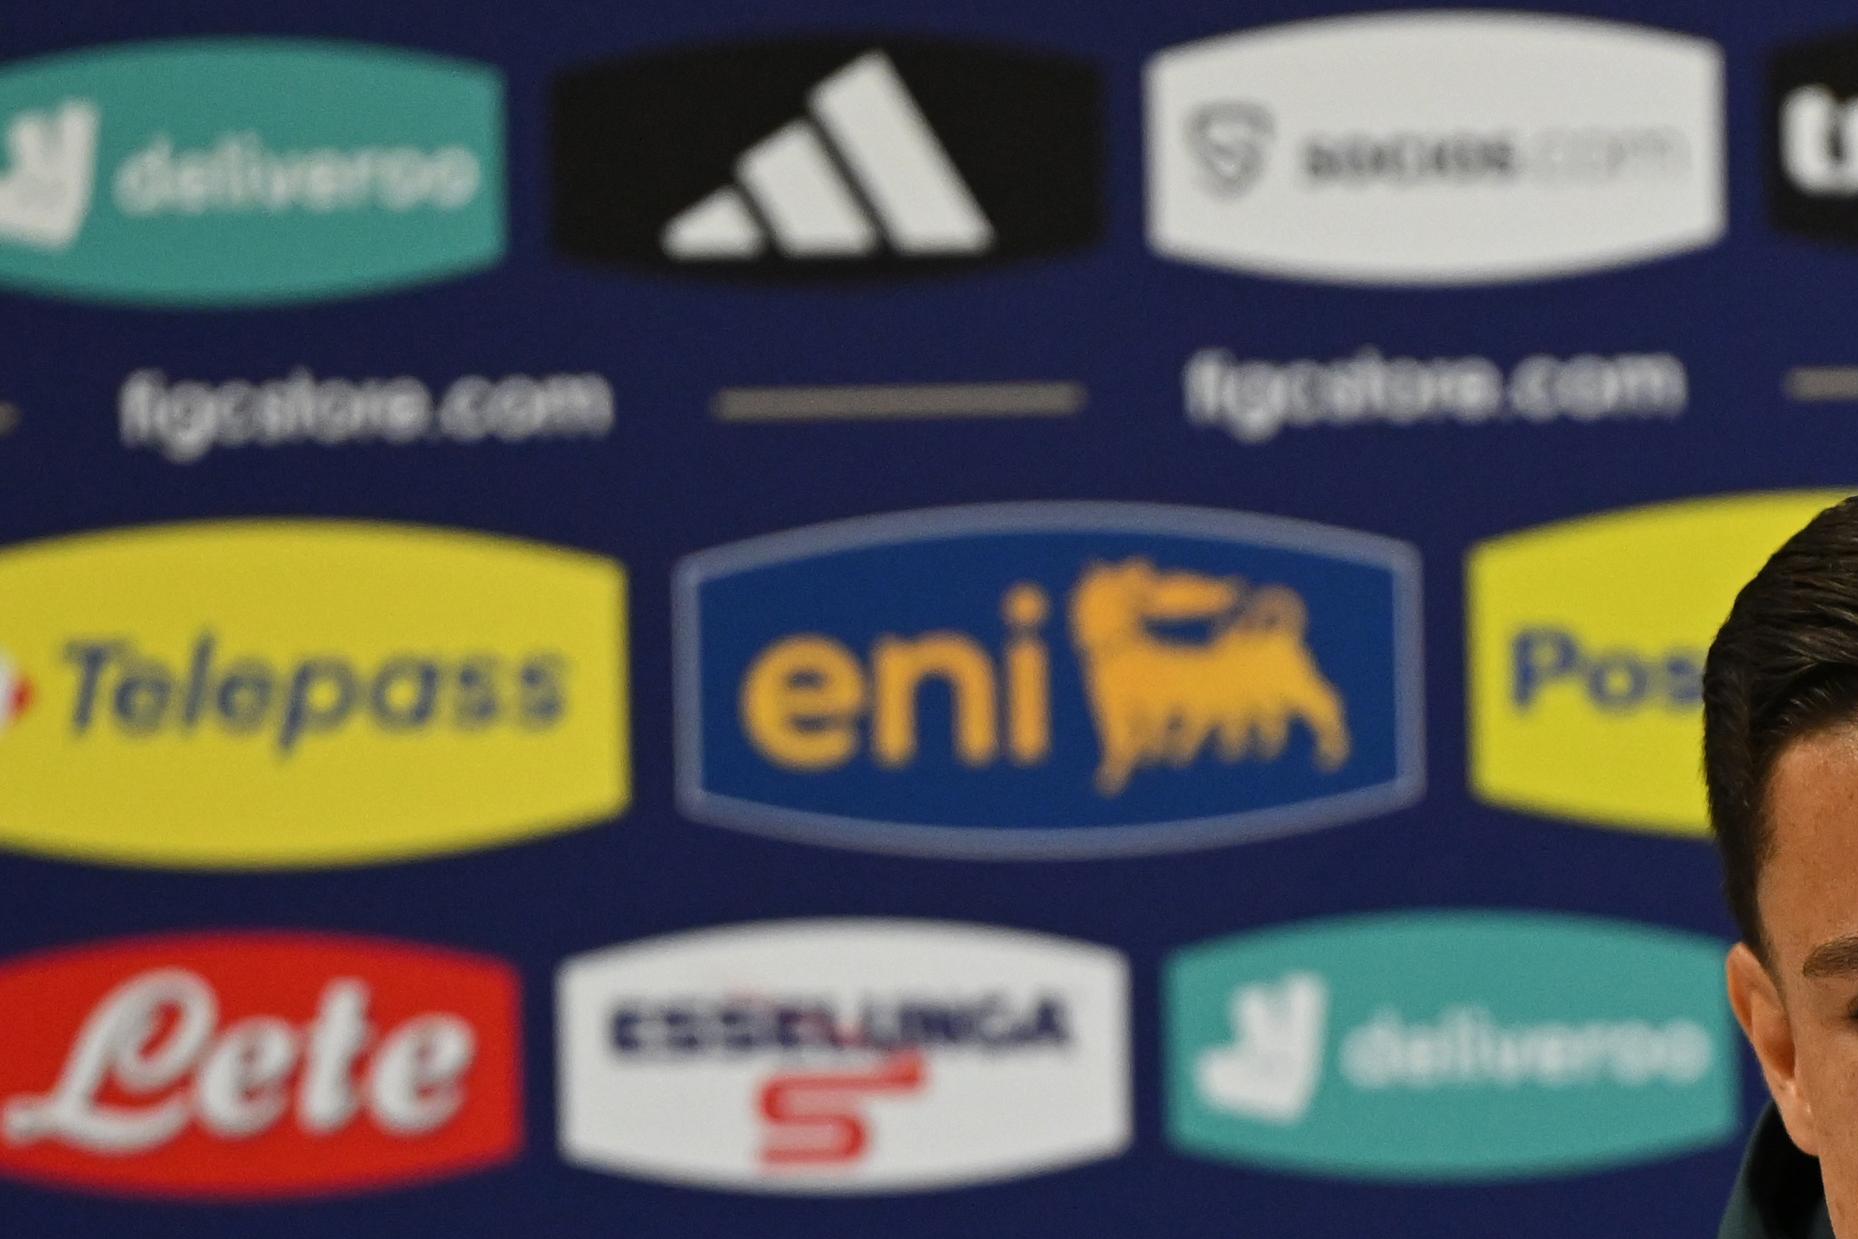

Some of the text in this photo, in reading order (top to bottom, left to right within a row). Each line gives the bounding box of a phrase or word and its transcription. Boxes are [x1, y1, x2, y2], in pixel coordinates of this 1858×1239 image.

[114, 133, 482, 215] deliveroo
[120, 372, 614, 460] figcstore.com
[1185, 350, 1687, 440] figcstore.com
[61, 630, 571, 758] Telepass
[741, 584, 1050, 770] eni
[2, 967, 477, 1155] Lete
[1340, 1006, 1715, 1088] deliveroo
